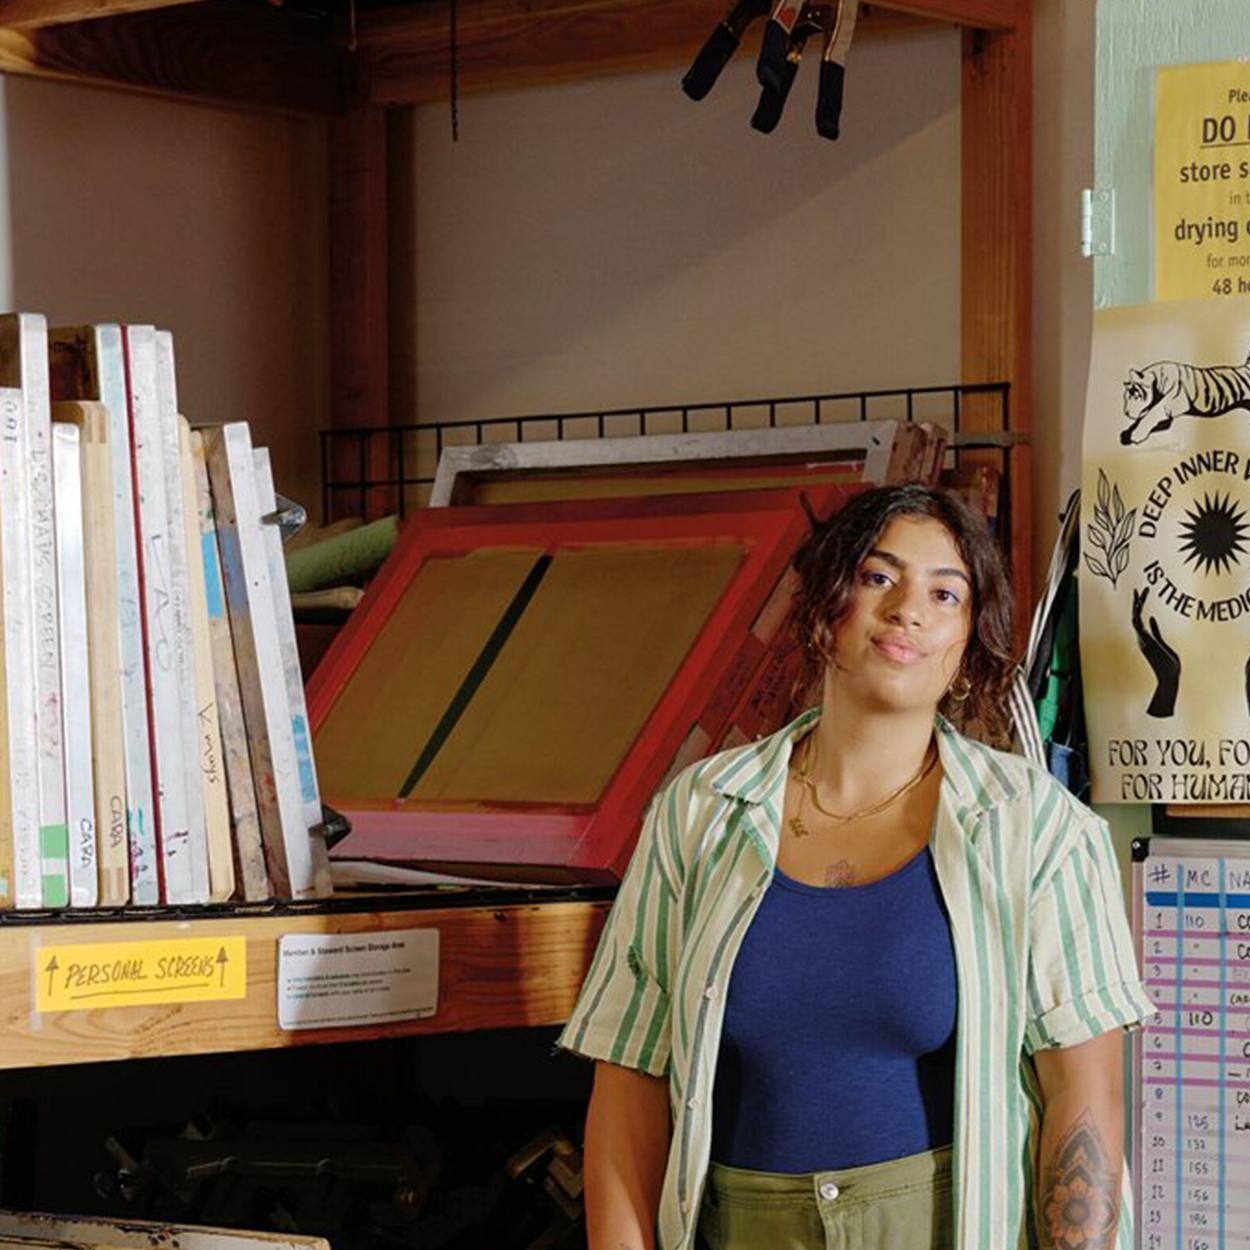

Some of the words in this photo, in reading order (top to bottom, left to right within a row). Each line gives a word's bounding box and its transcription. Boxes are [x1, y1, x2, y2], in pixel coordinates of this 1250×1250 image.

[1202, 116, 1236, 143] DO
[1179, 162, 1231, 183] store
[1229, 191, 1241, 205] in
[1174, 217, 1239, 245] drying
[1207, 253, 1224, 268] for
[1212, 279, 1232, 295] 48
[1138, 476, 1173, 539] DEEP
[1172, 449, 1239, 485] INNER
[1143, 560, 1160, 585] IS
[1157, 578, 1196, 620] THE
[1108, 740, 1148, 767] FOR
[1154, 739, 1212, 770] YOU,
[1121, 774, 1163, 800] FOR
[1148, 864, 1170, 883] #
[1186, 869, 1212, 887] MC
[64, 957, 148, 989] PERSONAL
[155, 955, 216, 979] SCREENS
